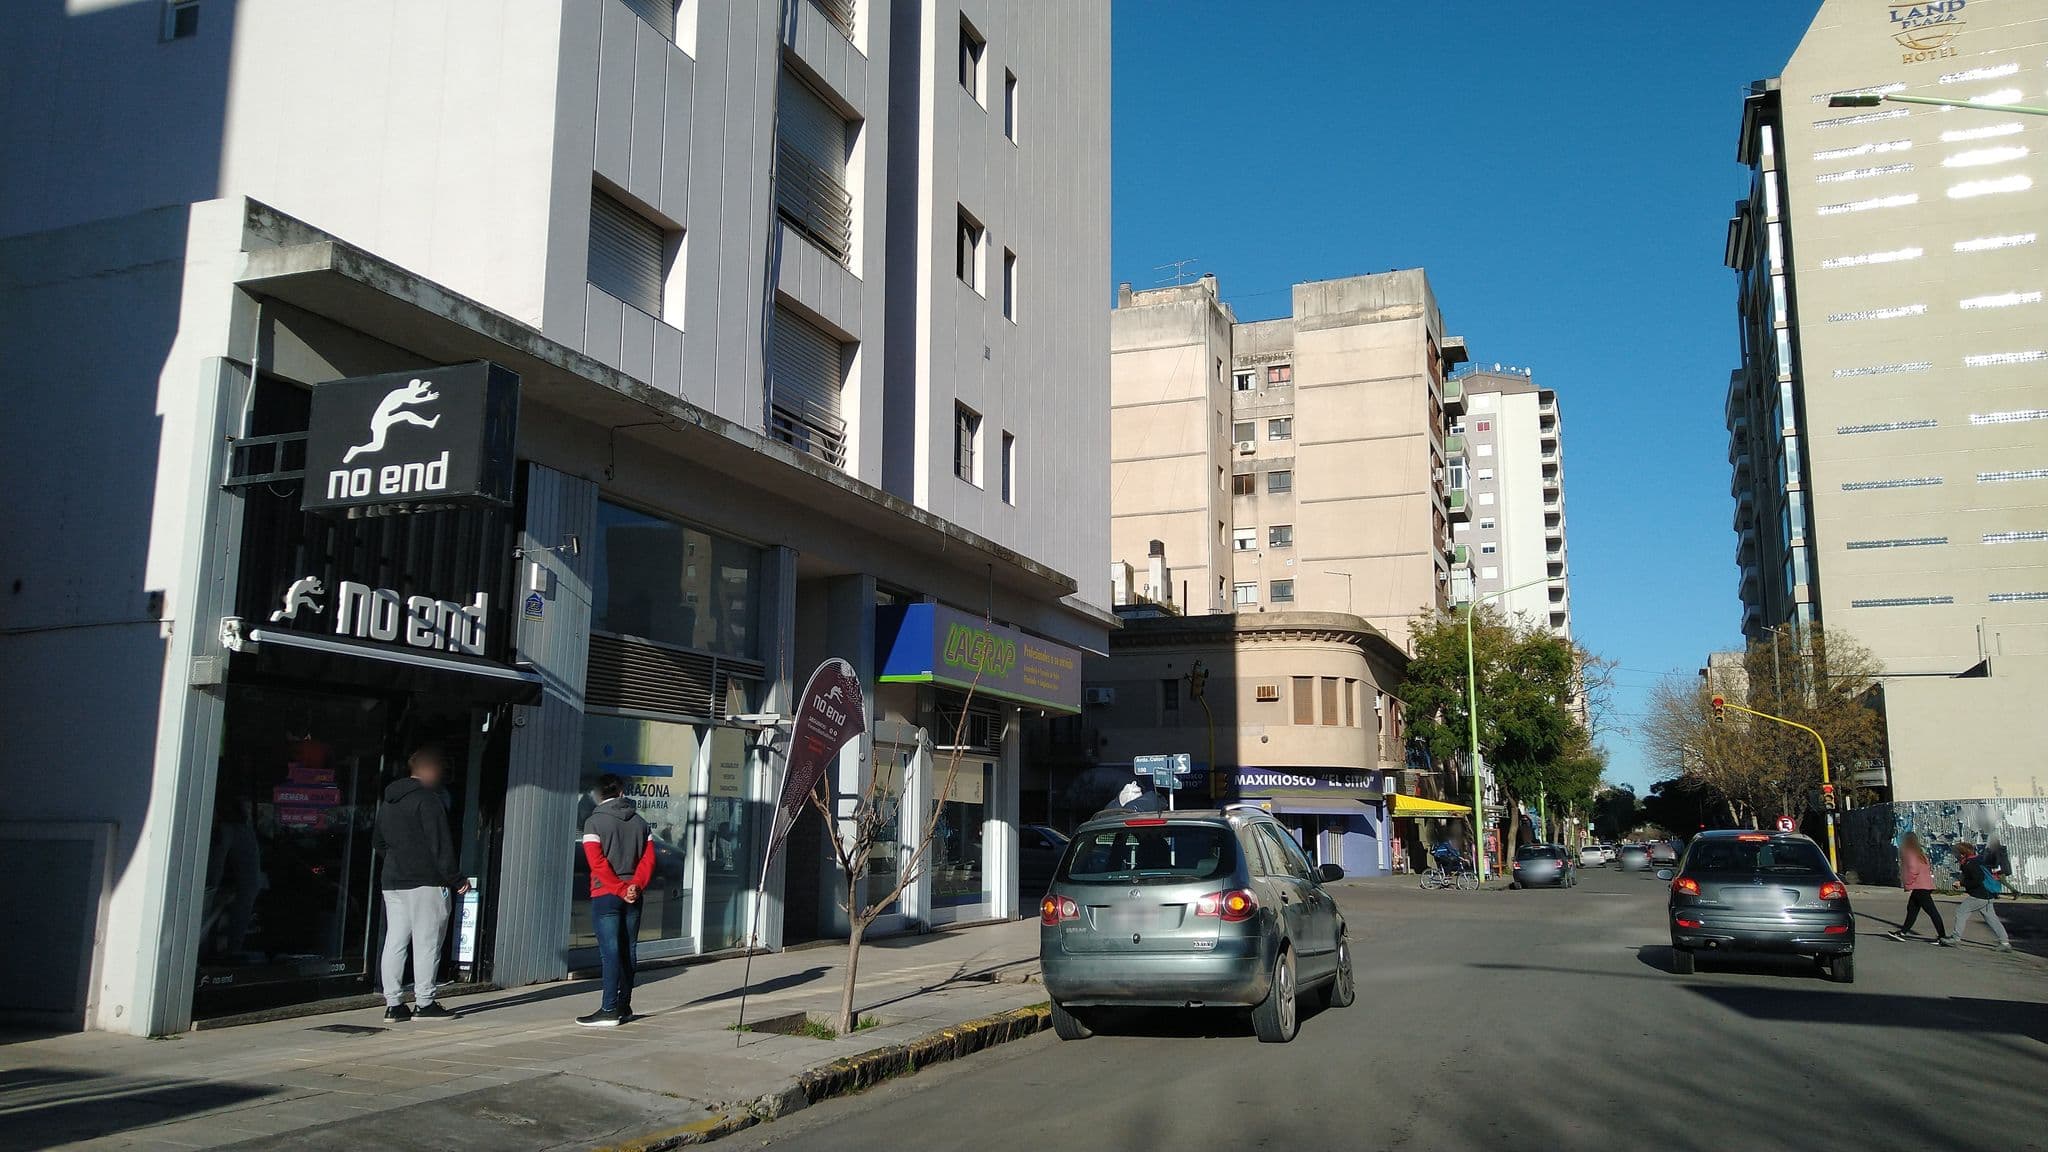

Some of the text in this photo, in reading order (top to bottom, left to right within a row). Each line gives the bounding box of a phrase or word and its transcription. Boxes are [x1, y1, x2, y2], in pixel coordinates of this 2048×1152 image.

[1889, 0, 1966, 23] LAND
[1902, 14, 1956, 29] PLAZA
[1903, 47, 1958, 64] HOTEL
[327, 451, 449, 499] no end
[336, 581, 400, 641] no
[407, 592, 489, 656] end
[813, 695, 827, 713] no
[826, 706, 847, 726] end
[1234, 774, 1316, 786] MAXIKIOSCO
